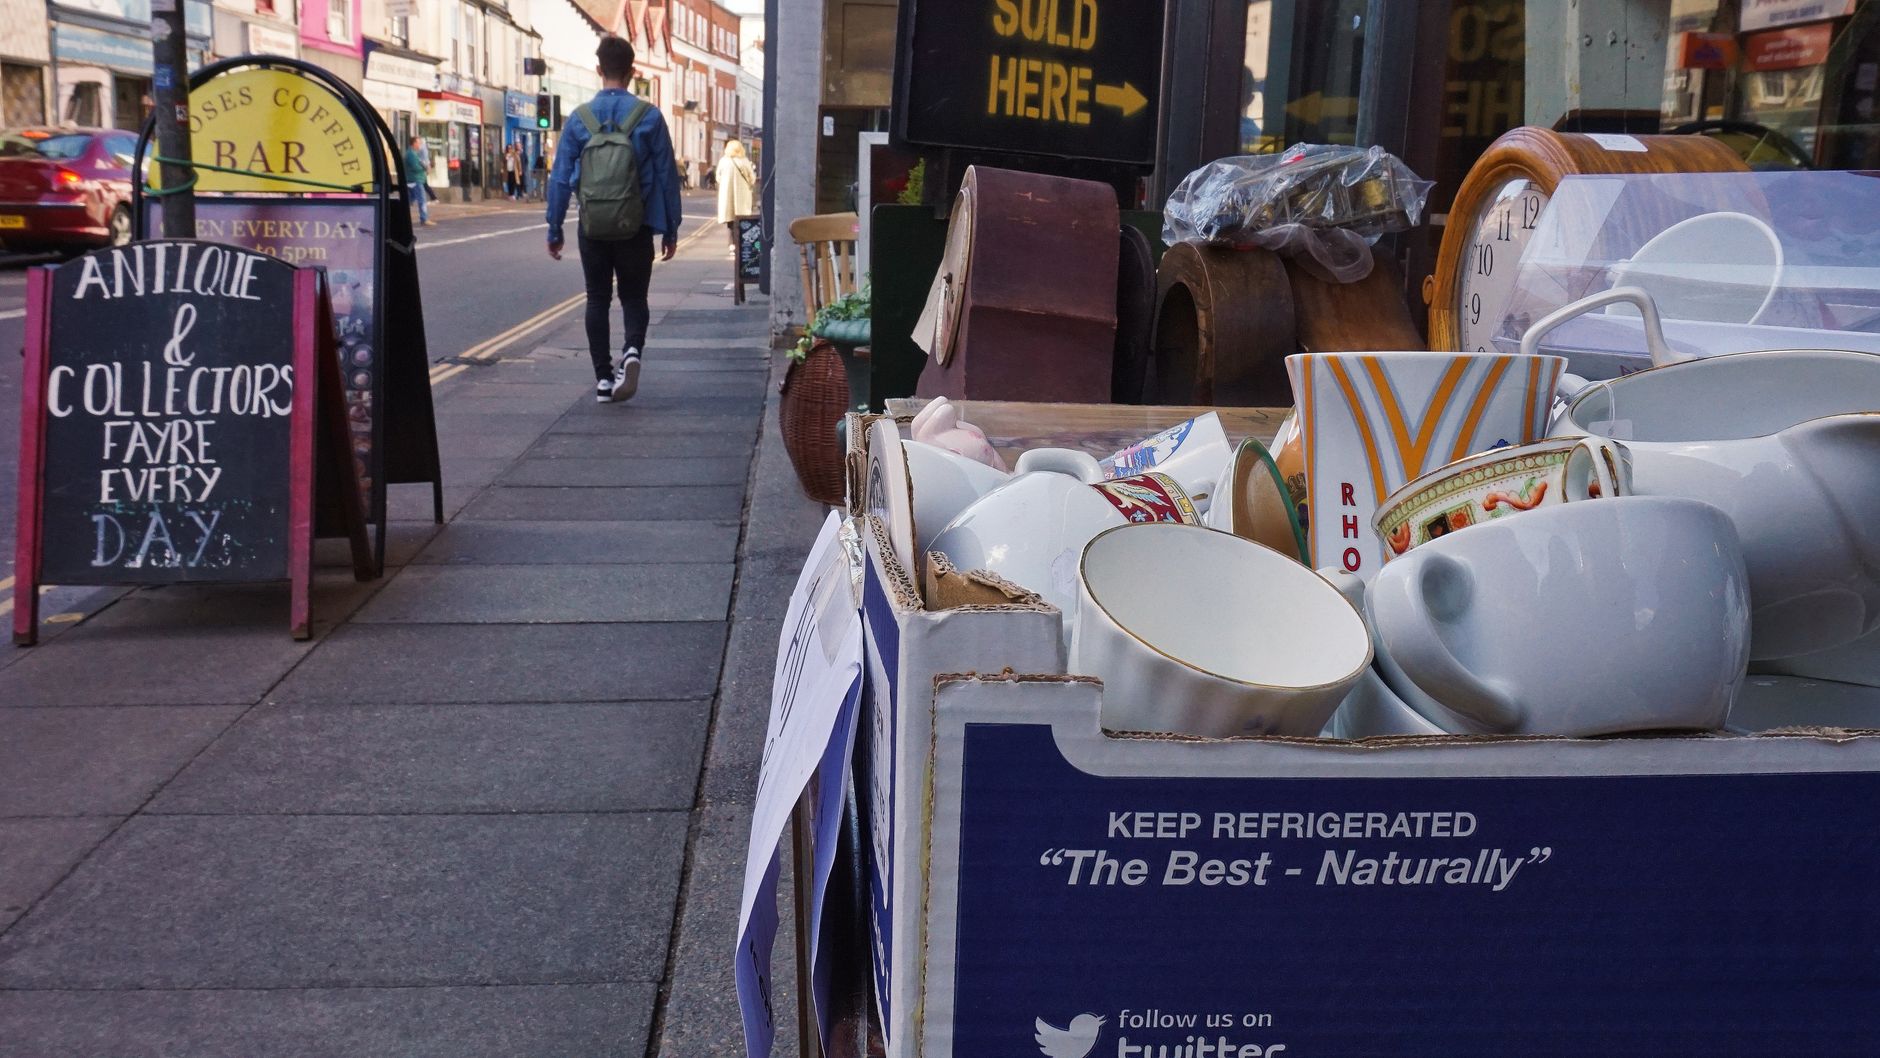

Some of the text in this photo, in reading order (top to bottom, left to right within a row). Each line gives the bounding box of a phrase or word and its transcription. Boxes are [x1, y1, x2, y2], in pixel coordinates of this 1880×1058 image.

[992, 0, 1098, 50] SOLD
[987, 55, 1092, 124] HERE
[189, 86, 360, 176] OSES COFFEE
[213, 140, 310, 174] BAR
[232, 220, 309, 238] EVERY
[314, 220, 362, 239] DAY
[1497, 209, 1511, 242] 11
[1522, 196, 1540, 230] 12
[73, 243, 267, 300] ANTIQUE
[281, 245, 327, 262] 5pm
[1477, 244, 1493, 277] 10
[1471, 293, 1481, 325] 9
[163, 303, 197, 366] &
[47, 361, 294, 418] COLLECTORS
[103, 419, 216, 464] FAYRE
[100, 464, 222, 503] EVERY
[91, 509, 221, 568] DAY
[1107, 812, 1477, 839] KEEP REFRIGERATED
[1162, 849, 1271, 886] Best
[1118, 1009, 1272, 1028] follow us on
